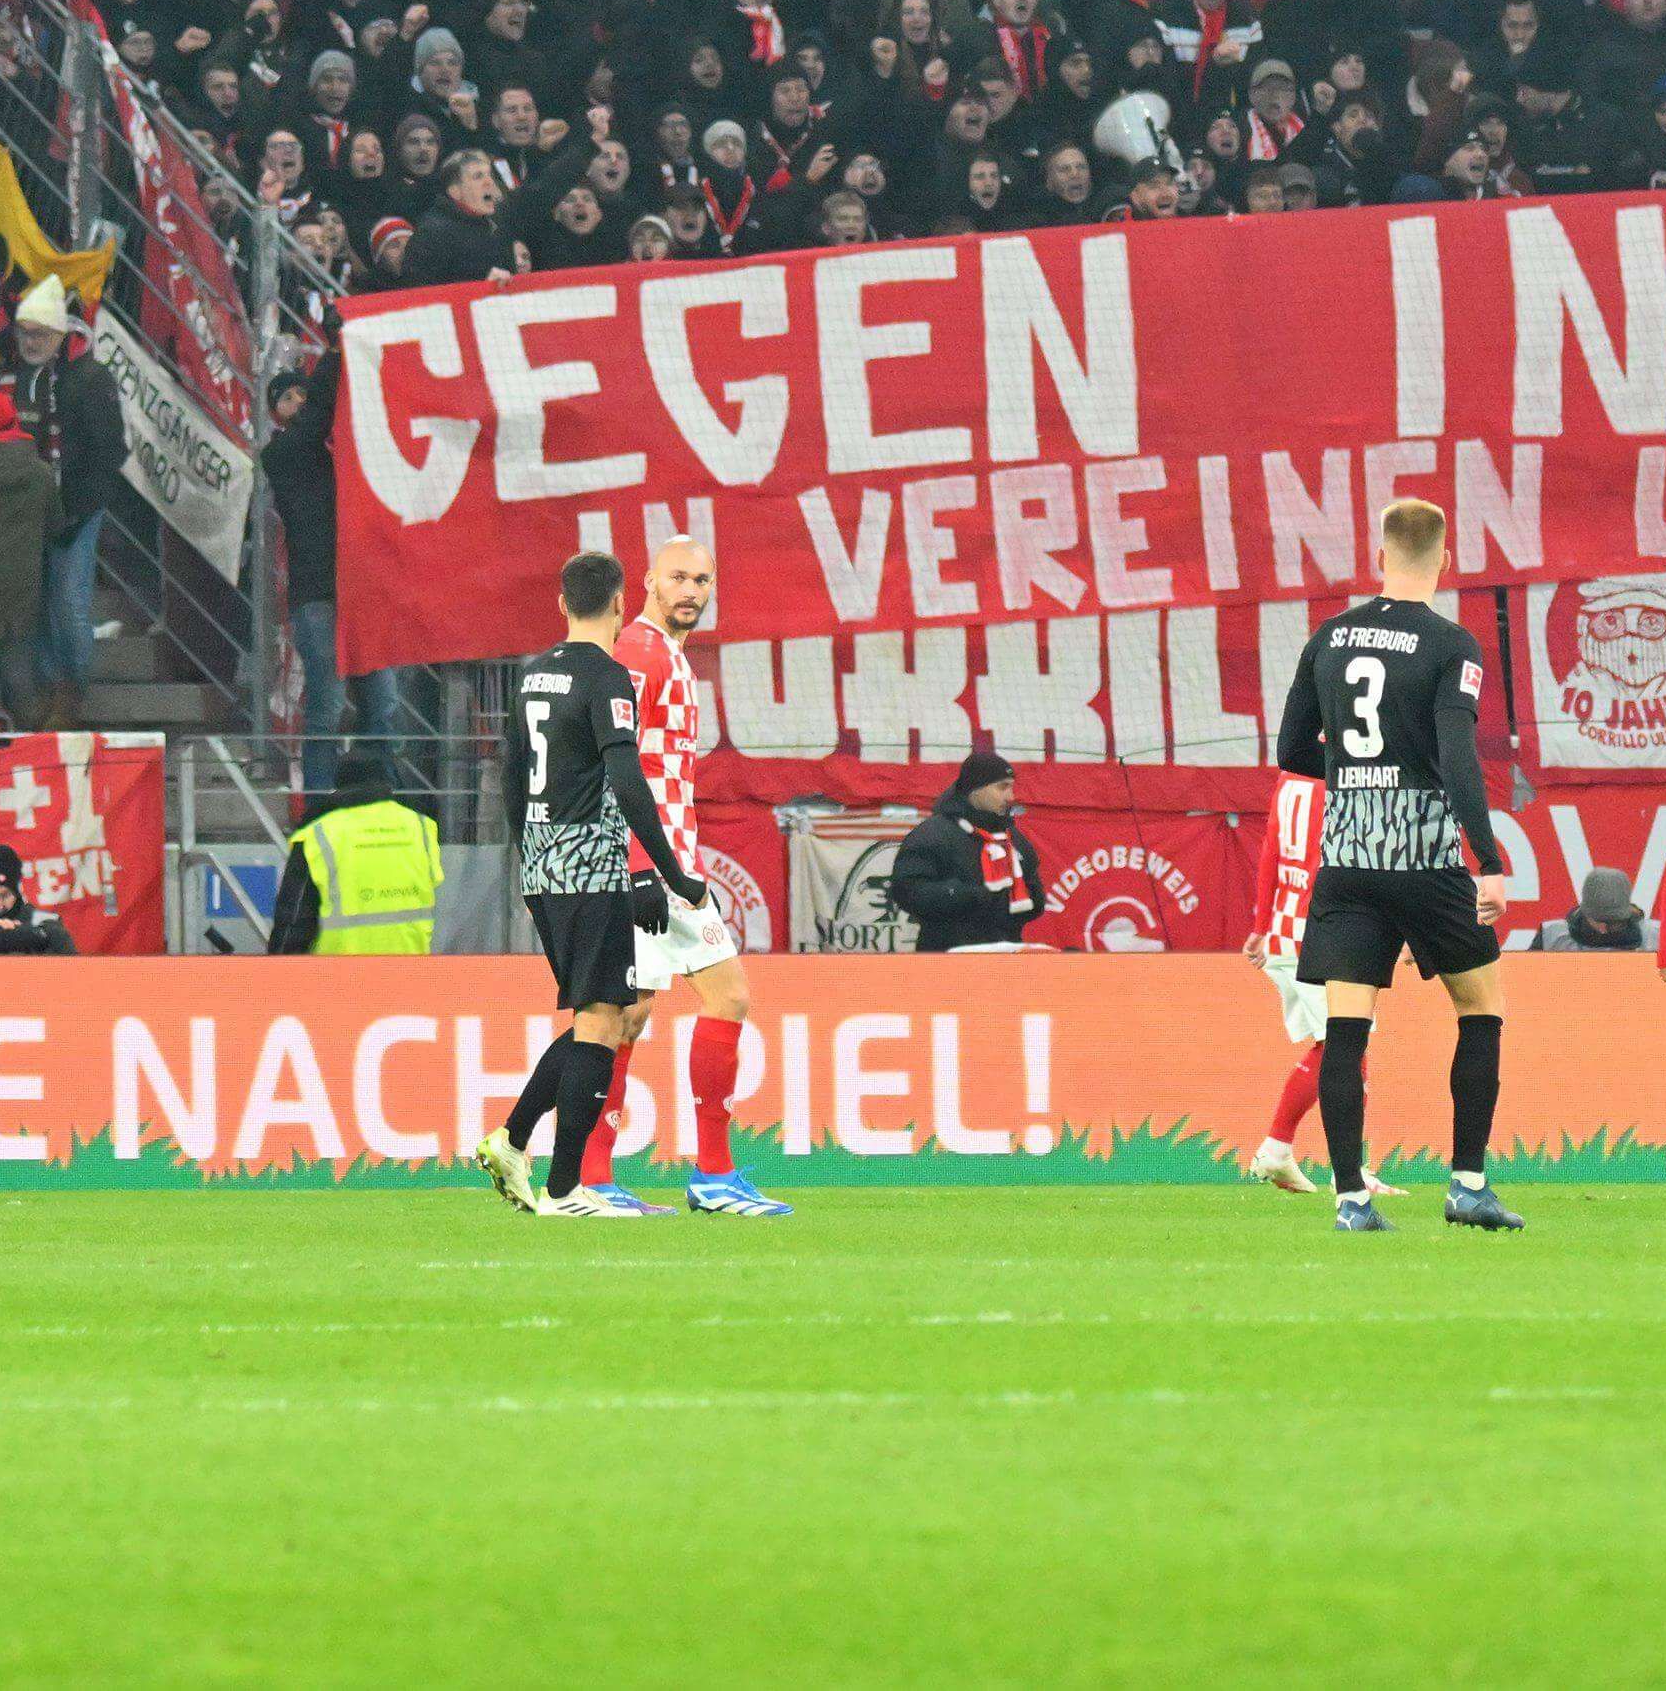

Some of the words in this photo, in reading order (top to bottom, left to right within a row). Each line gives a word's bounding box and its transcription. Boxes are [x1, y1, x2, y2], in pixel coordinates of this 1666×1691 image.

[341, 232, 1141, 525] GEGEN
[797, 439, 1544, 624] VEREINEN
[1329, 627, 1349, 648] SC
[1348, 627, 1420, 654] FREIBURG
[525, 700, 551, 795] 5
[1342, 656, 1386, 758] 3
[1560, 686, 1594, 721] 10
[1044, 846, 1200, 915] VIDEOBEWEIS
